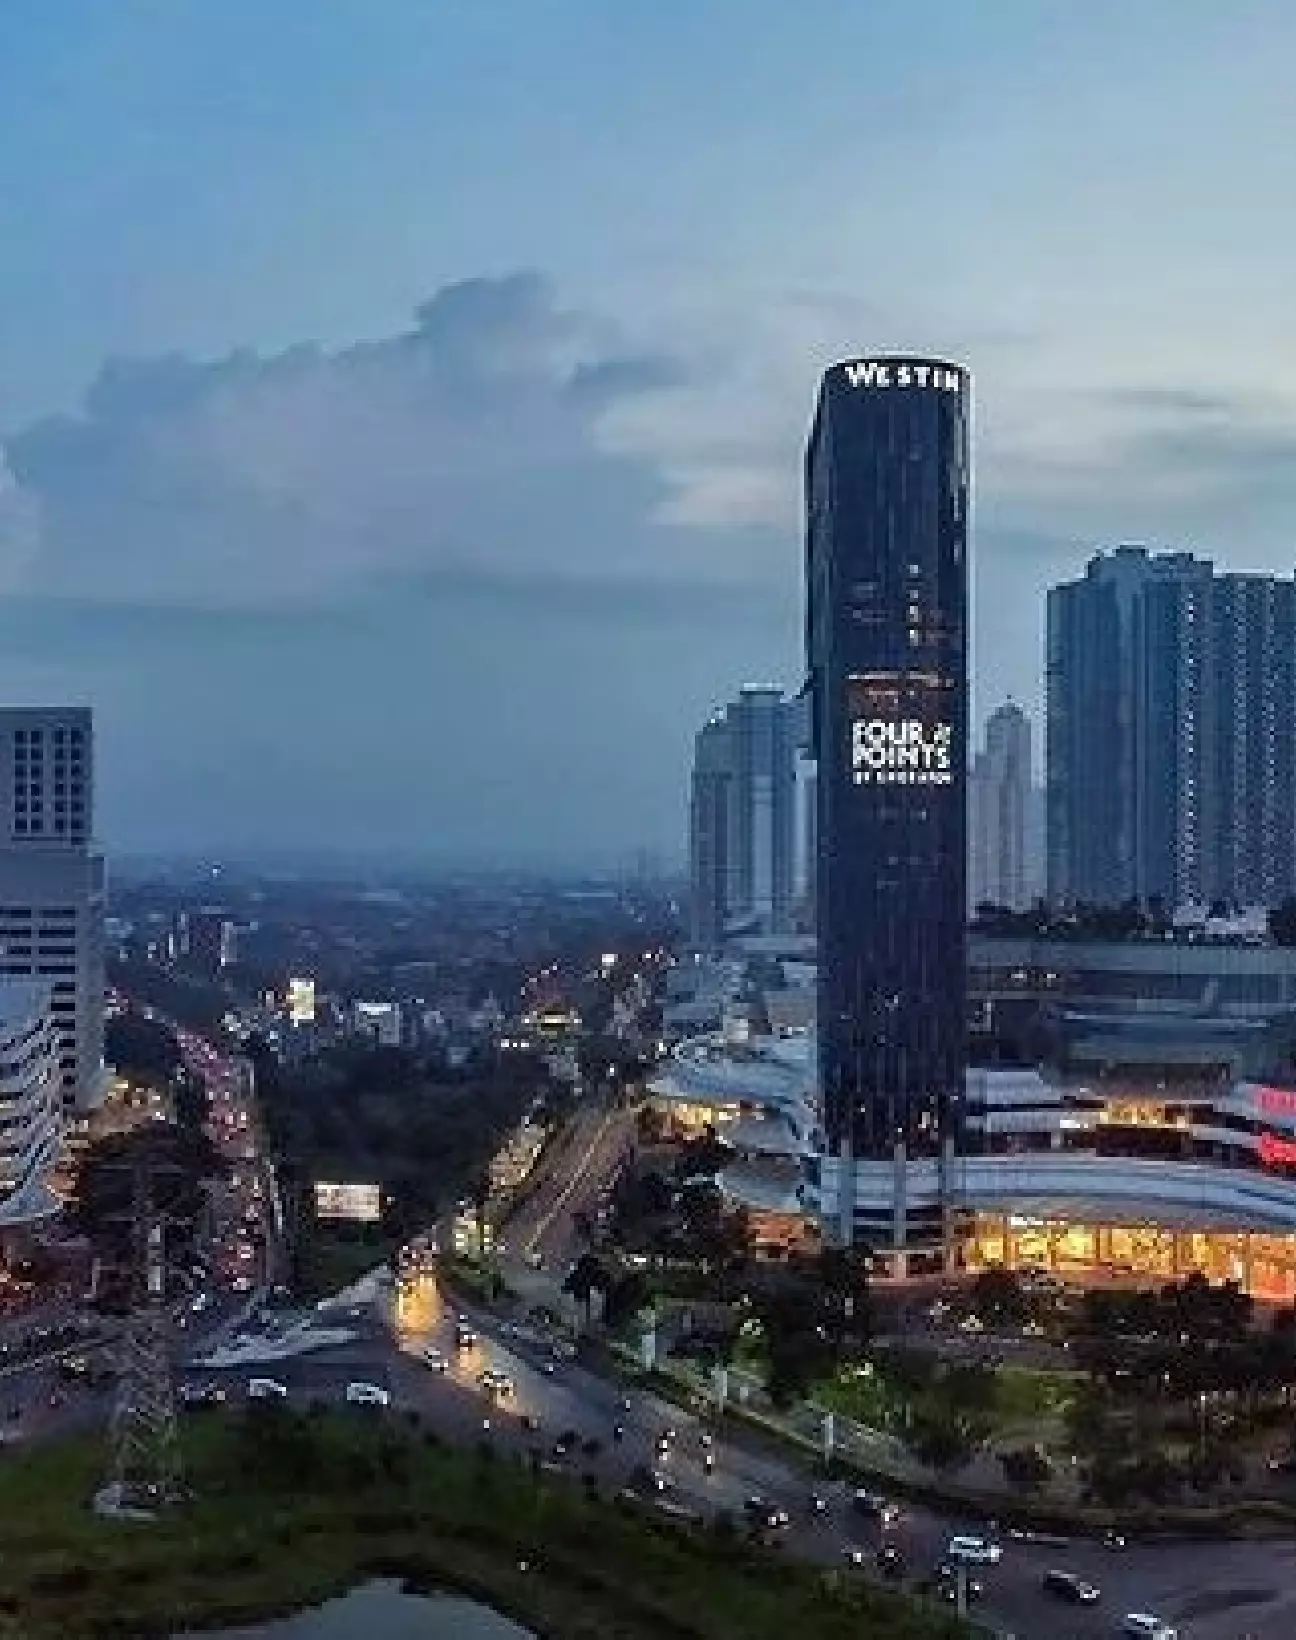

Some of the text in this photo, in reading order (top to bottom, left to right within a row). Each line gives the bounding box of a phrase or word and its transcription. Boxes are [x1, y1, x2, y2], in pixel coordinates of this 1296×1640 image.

[845, 362, 959, 391] WESTIN
[852, 719, 923, 745] FOUR
[852, 743, 951, 769] POINTS
